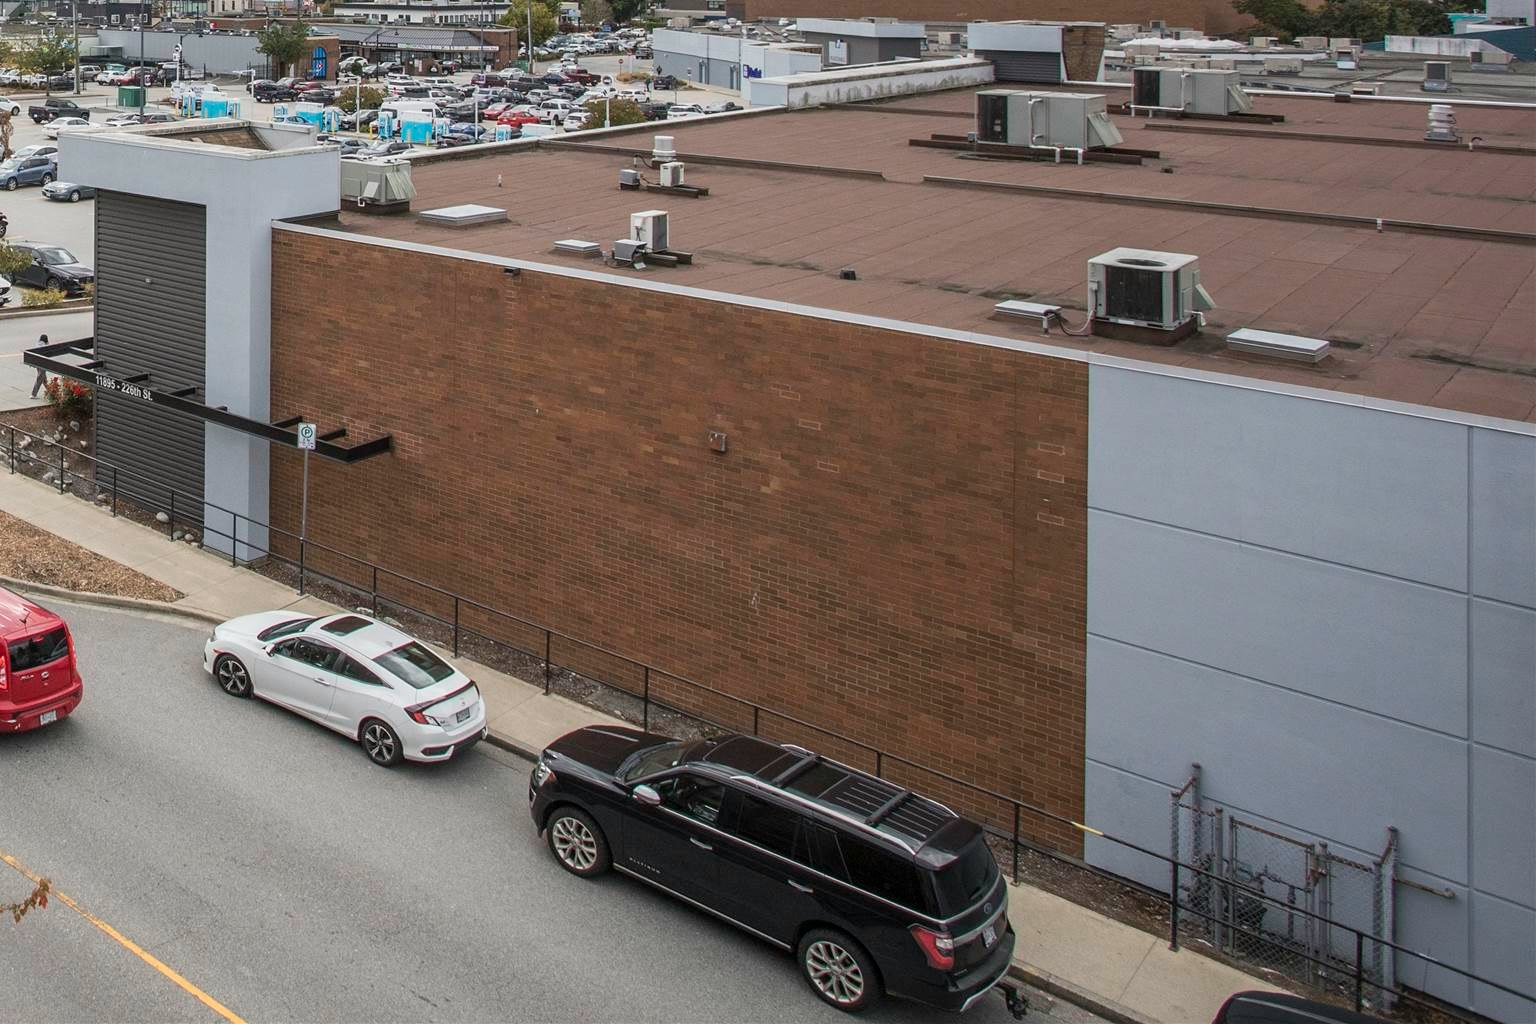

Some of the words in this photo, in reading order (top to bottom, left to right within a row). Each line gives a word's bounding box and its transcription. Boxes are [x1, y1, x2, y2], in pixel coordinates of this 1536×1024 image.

[96, 375, 115, 389] 11895
[121, 382, 141, 397] 226th
[143, 389, 153, 401] St.
